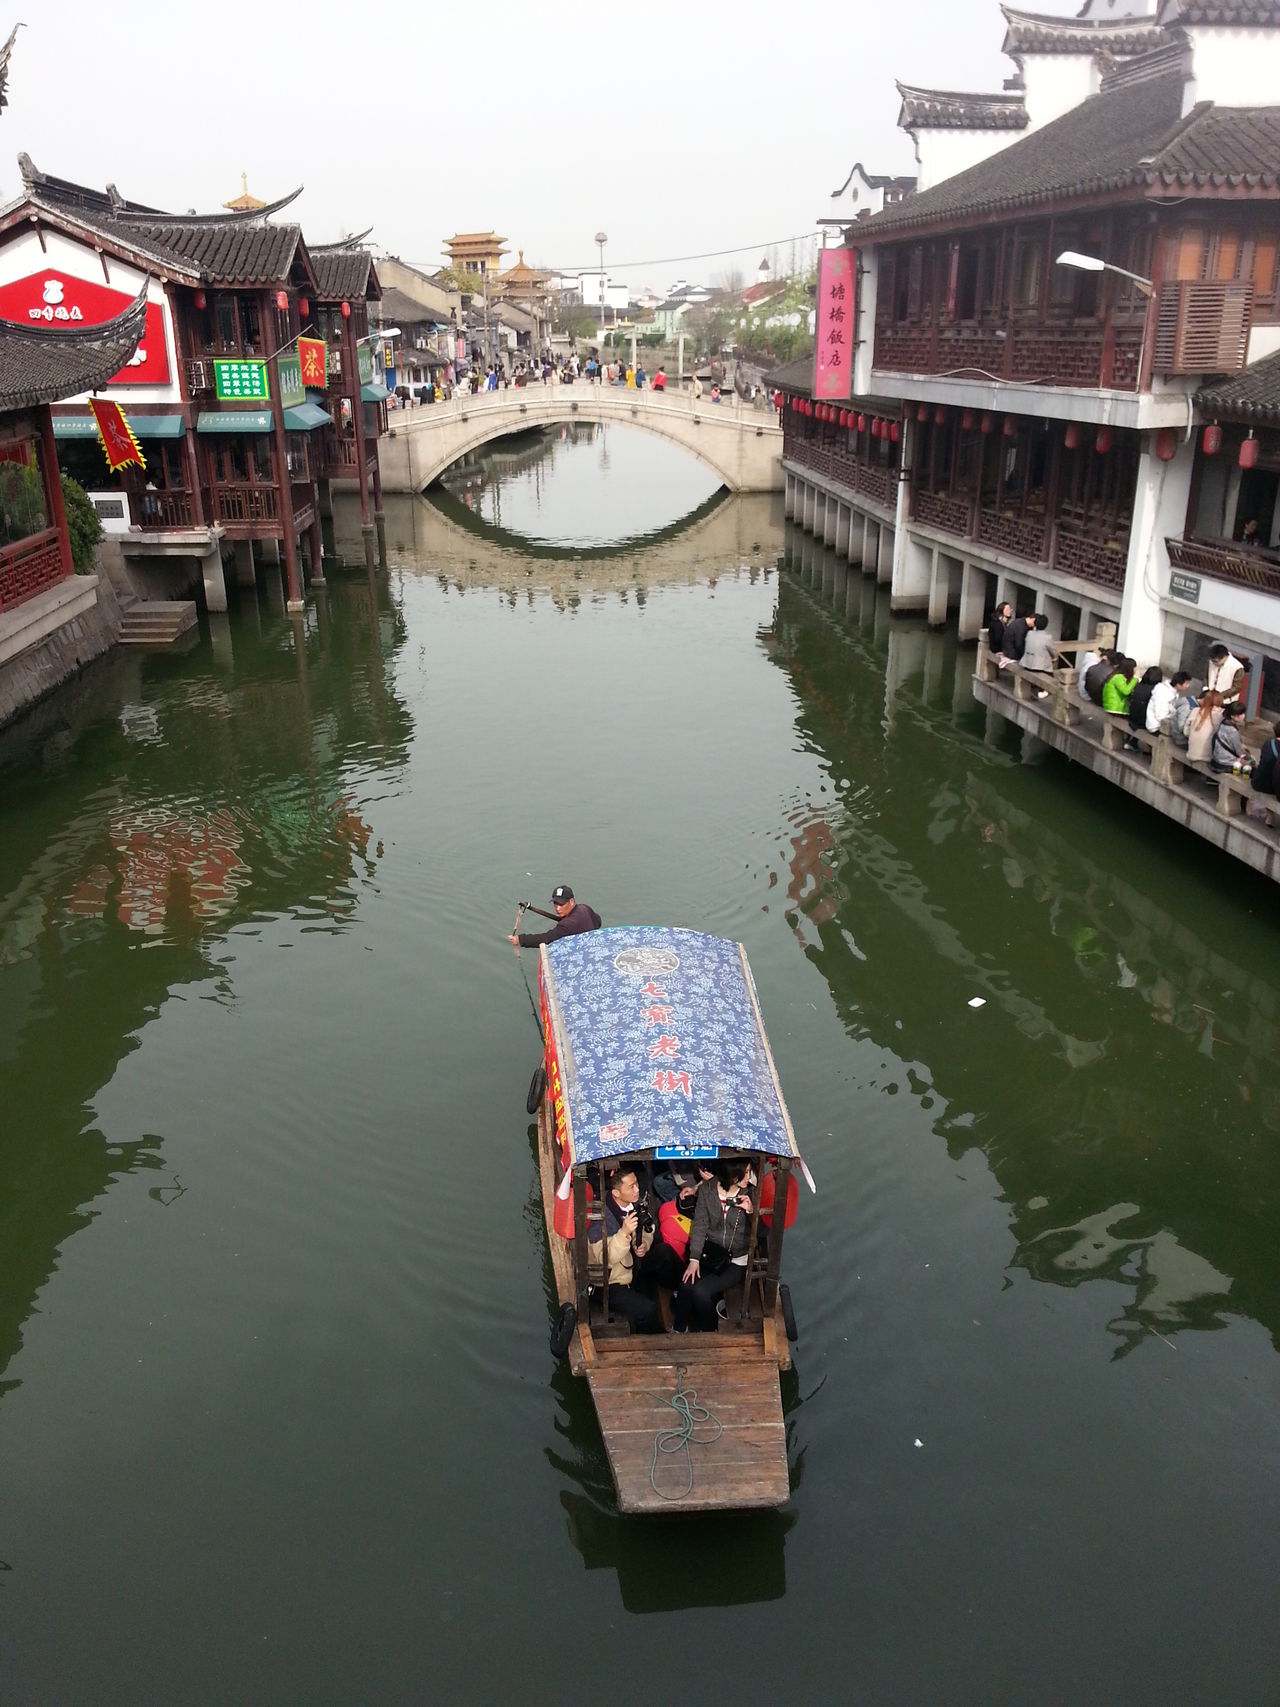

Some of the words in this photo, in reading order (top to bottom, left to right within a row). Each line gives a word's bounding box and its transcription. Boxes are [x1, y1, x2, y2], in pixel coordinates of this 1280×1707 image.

[827, 282, 846, 368] 塘橋飯店
[303, 347, 324, 378] 茶
